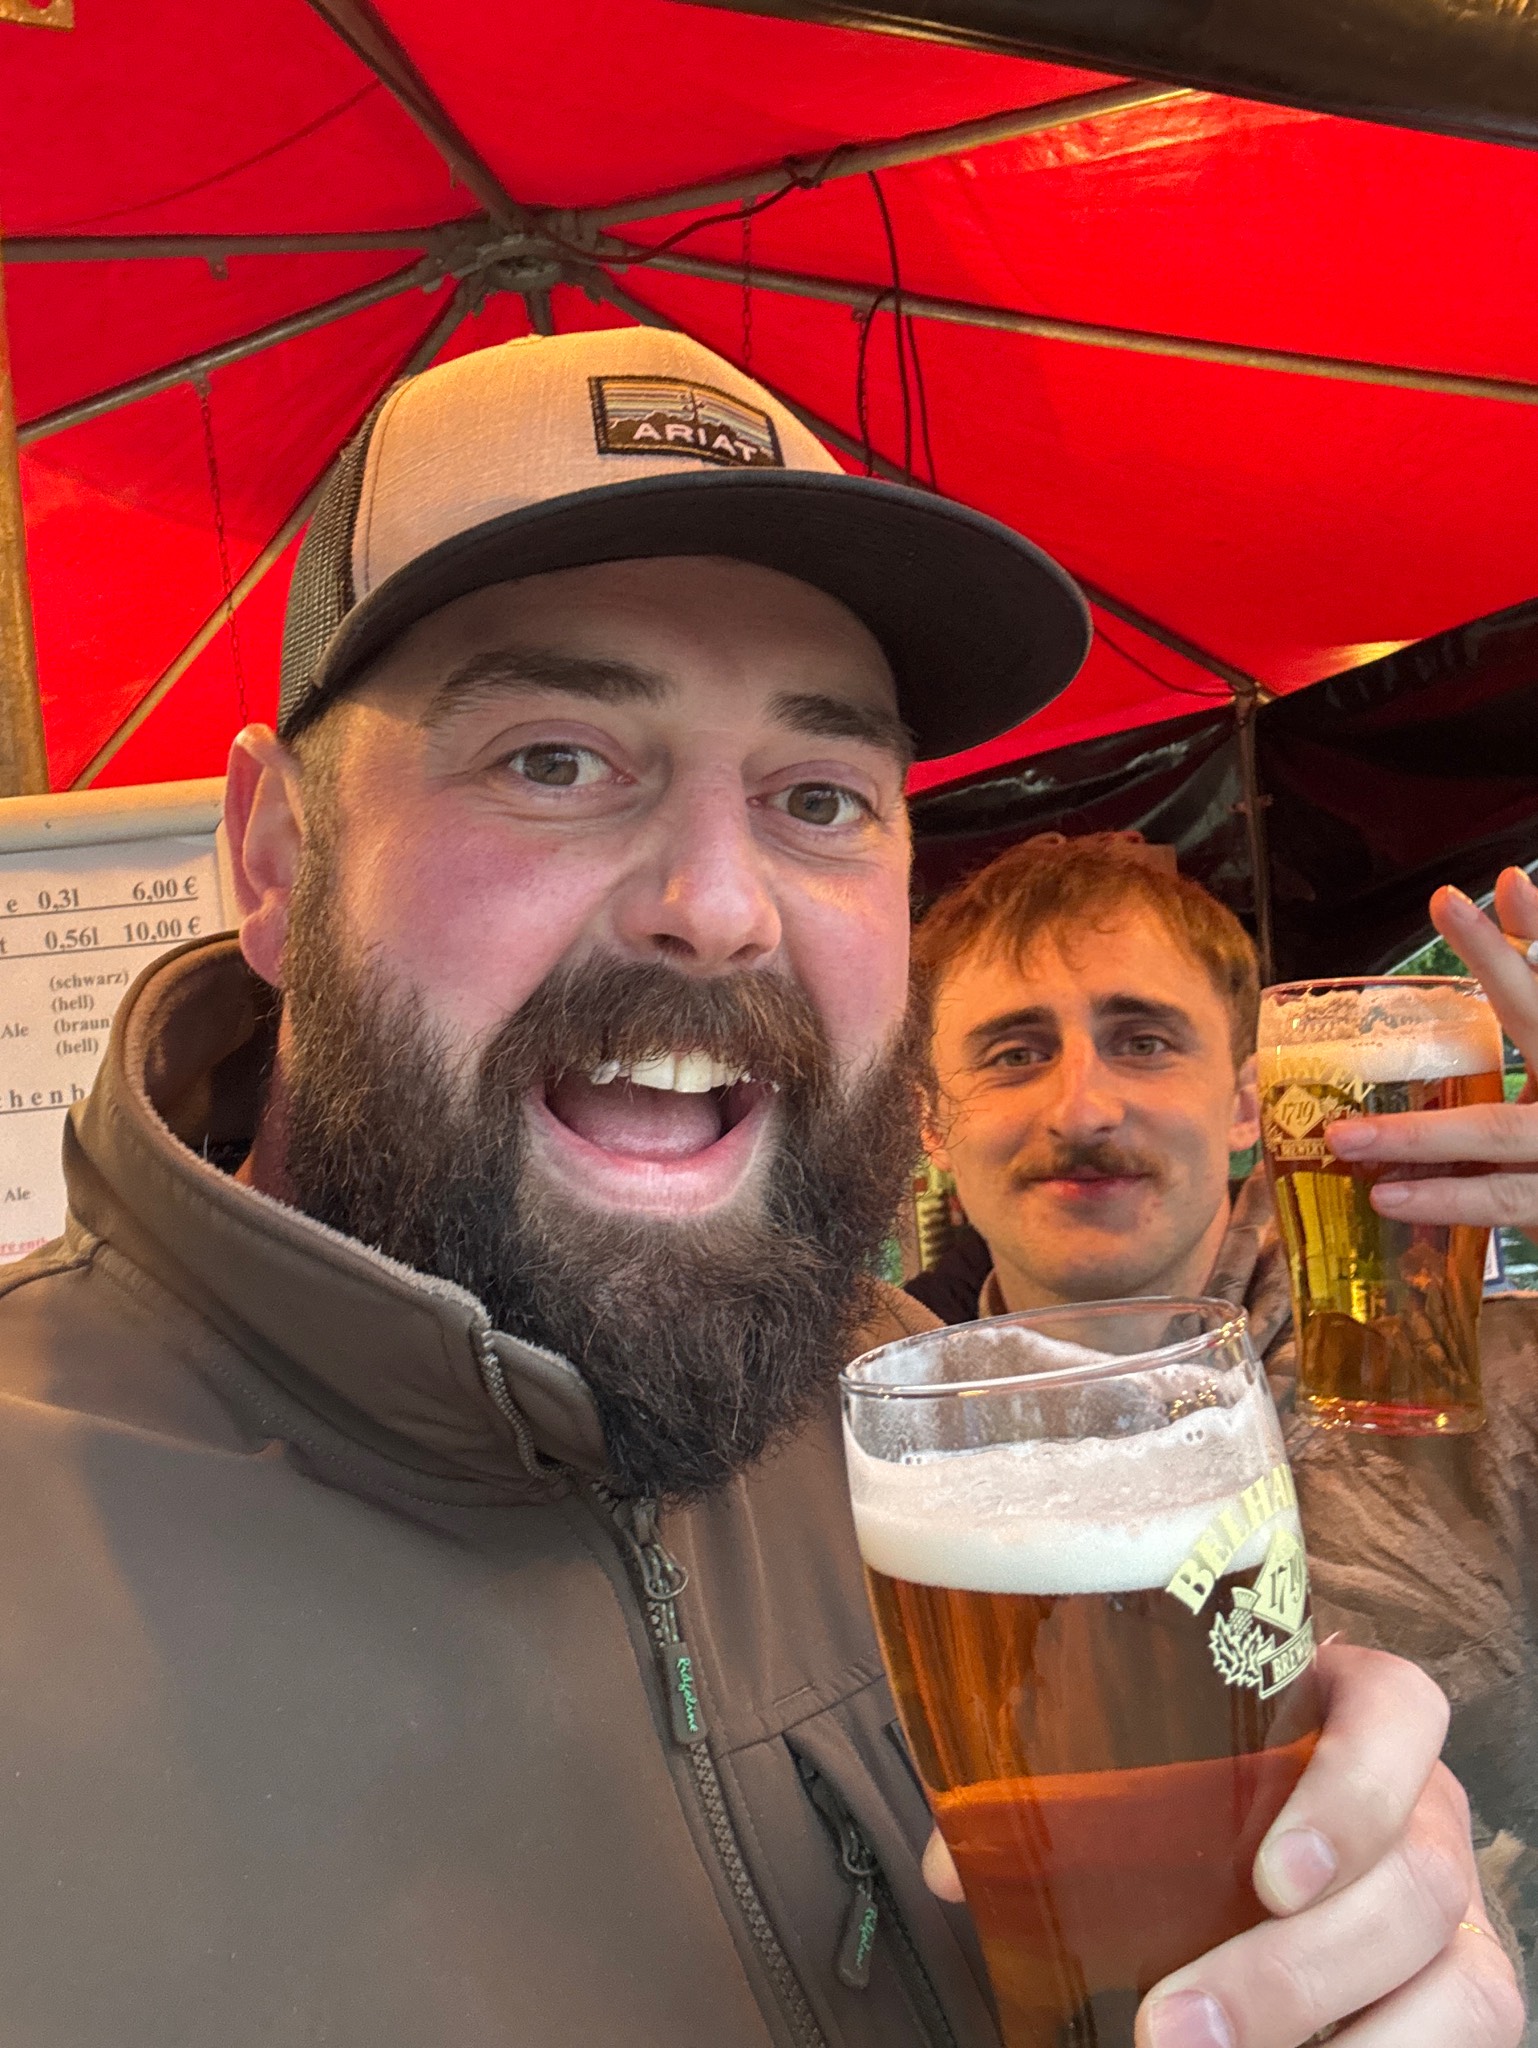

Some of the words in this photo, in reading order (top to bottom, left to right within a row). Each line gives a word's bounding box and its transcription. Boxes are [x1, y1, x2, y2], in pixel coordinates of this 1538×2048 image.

[633, 422, 757, 461] ARIAT
[50, 970, 129, 991] (schwarz)
[52, 994, 94, 1013] (hell)
[1, 1022, 30, 1039] Ale
[54, 1017, 110, 1035] (braun
[56, 1037, 99, 1056] (hell)
[1281, 1101, 1316, 1127] 1719
[5, 1187, 31, 1202] Ale
